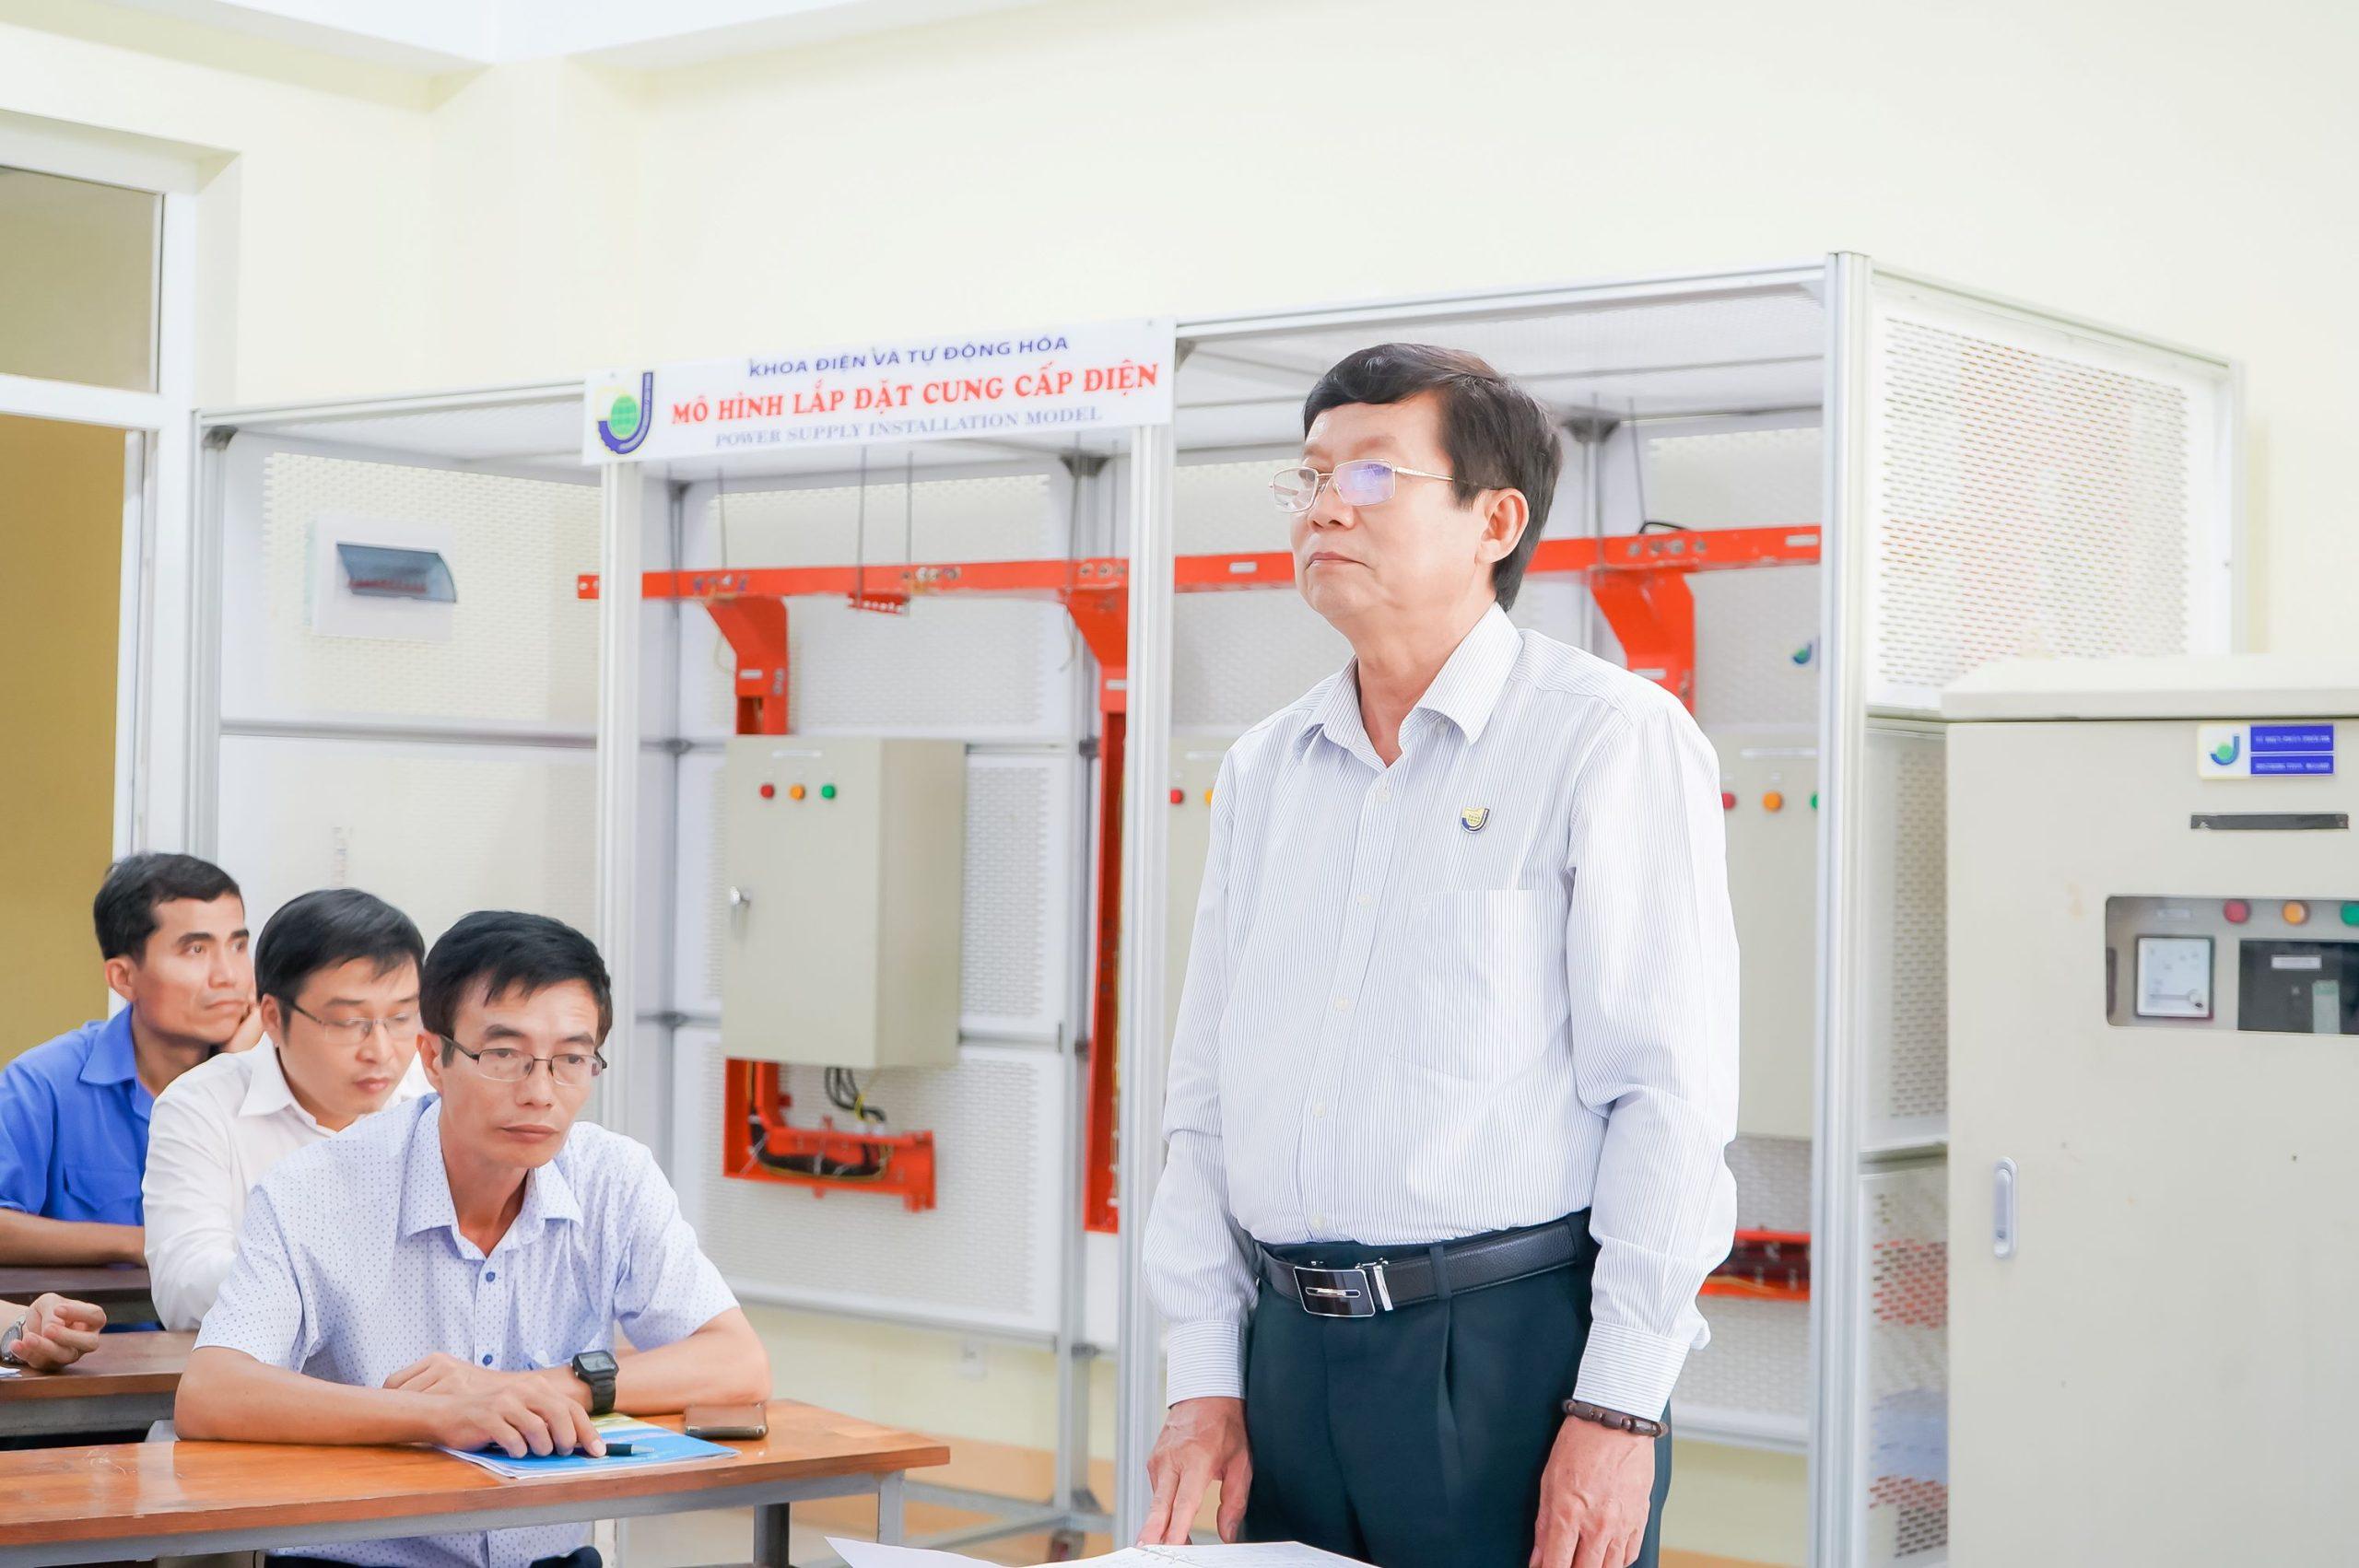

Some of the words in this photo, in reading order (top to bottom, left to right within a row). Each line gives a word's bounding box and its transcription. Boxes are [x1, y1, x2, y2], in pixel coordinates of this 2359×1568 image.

[749, 360, 808, 377] KHOA
[673, 394, 709, 424] MÔ
[718, 391, 784, 420] HÌNH
[792, 379, 845, 414] LẮP
[854, 380, 913, 415] ĐẶT
[922, 378, 1003, 404] CUNG
[1015, 360, 1074, 397] CẤP
[1083, 358, 1158, 396] ĐIỆN
[715, 428, 781, 447] POWER
[786, 422, 863, 443] SUPPLY
[869, 412, 1019, 438] INSTALLATION
[1026, 406, 1103, 426] MODEL
